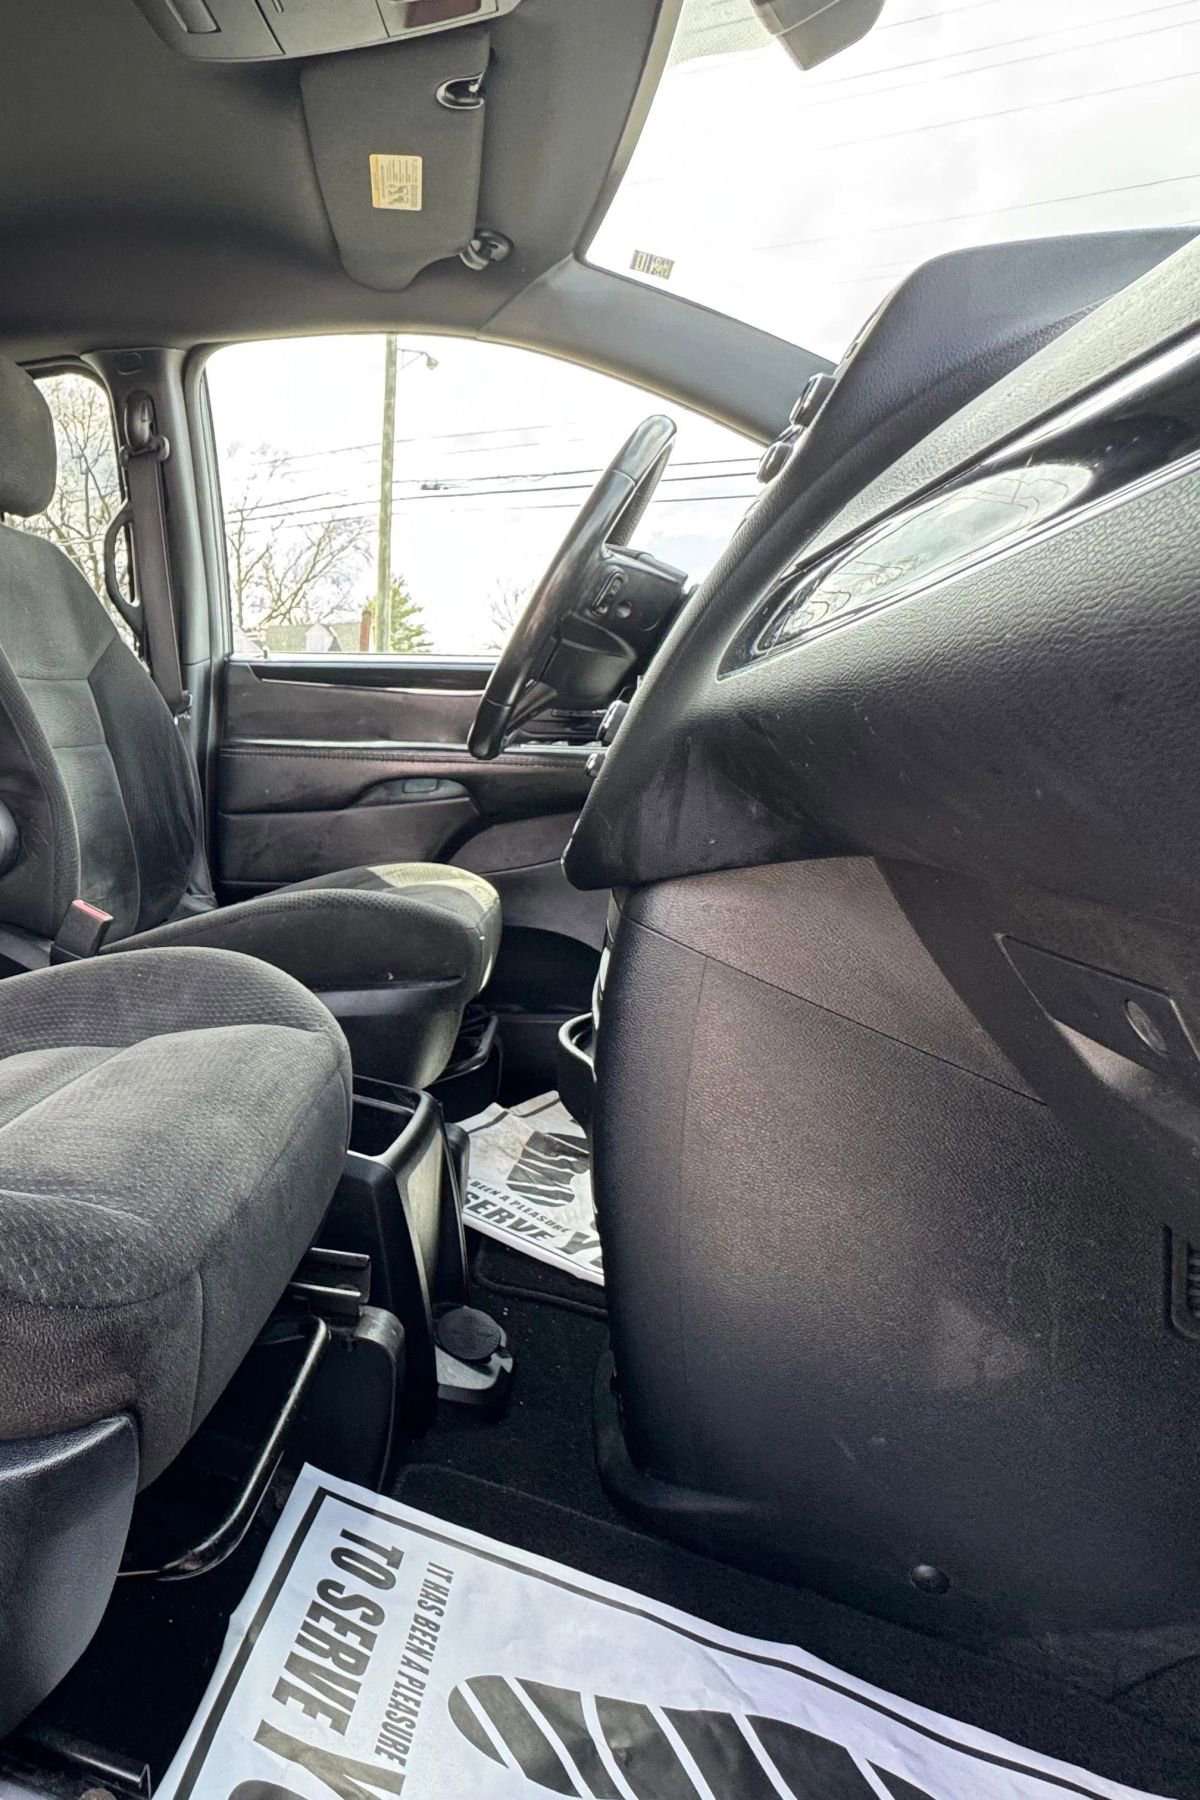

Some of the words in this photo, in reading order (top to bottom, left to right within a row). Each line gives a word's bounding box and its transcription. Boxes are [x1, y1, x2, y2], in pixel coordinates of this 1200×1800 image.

[470, 1181, 501, 1196] BEEN
[509, 1200, 571, 1233] PLEASURE
[330, 1528, 405, 1591] TO
[426, 1561, 454, 1584] IT
[417, 1578, 450, 1617] HAS
[271, 1578, 386, 1737] SERVE
[405, 1612, 441, 1663] BEEN
[400, 1654, 430, 1676] A
[374, 1669, 427, 1768] PLEASURE
